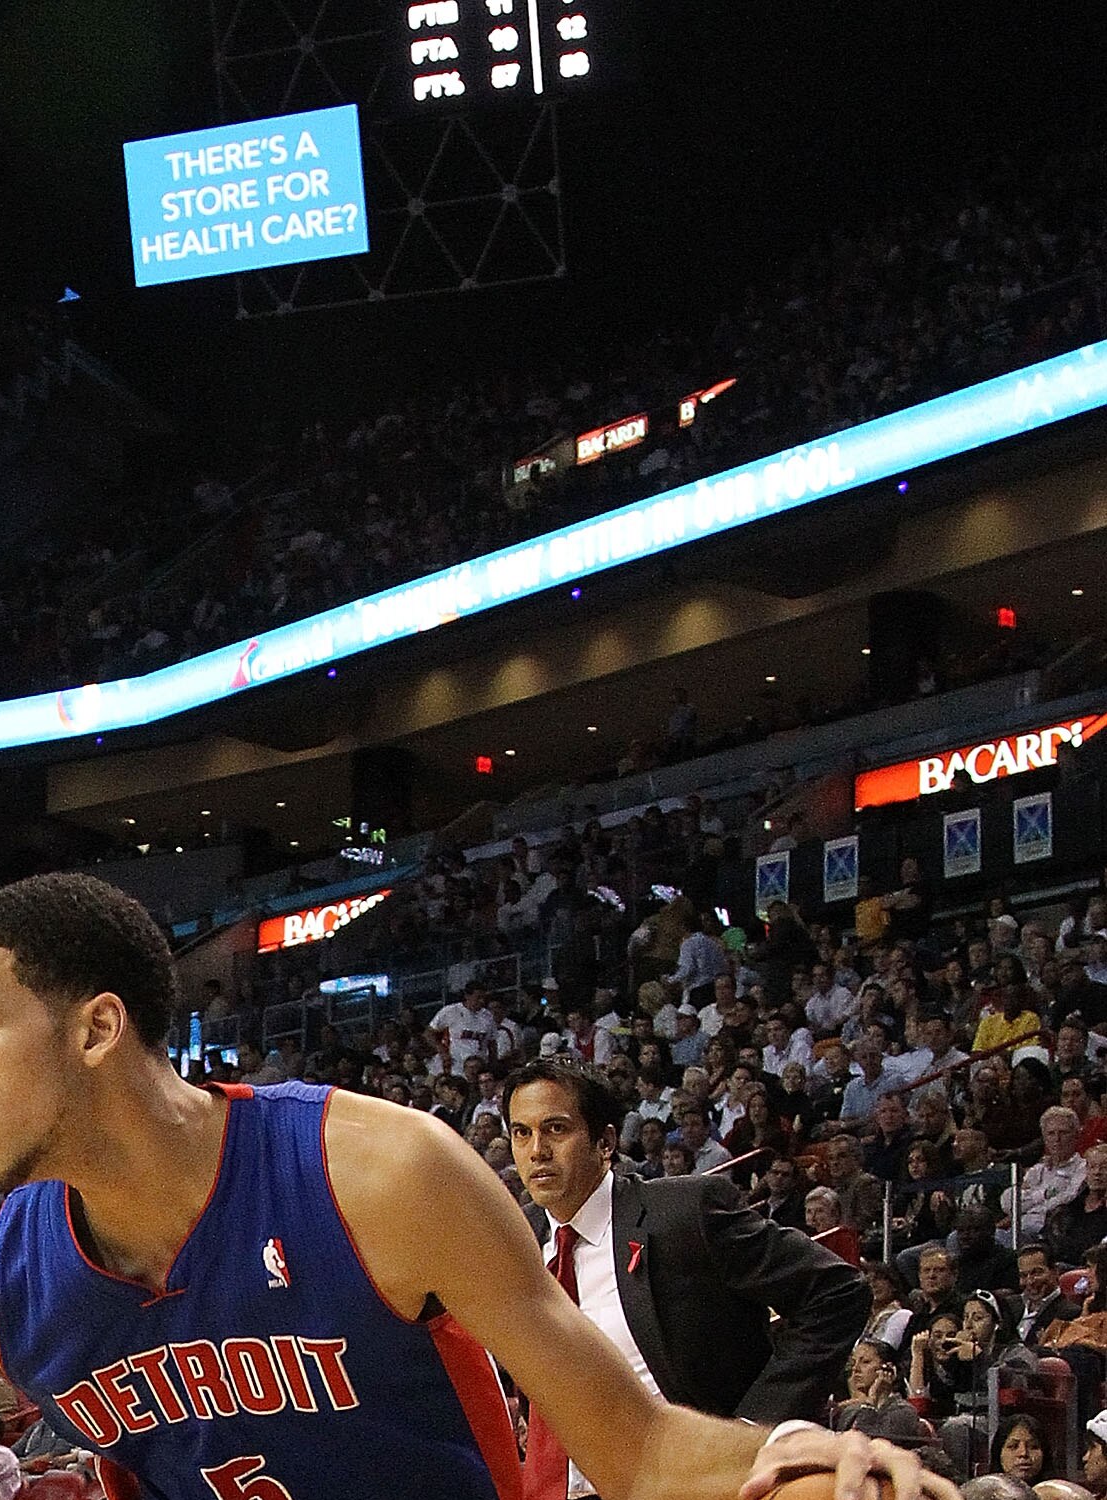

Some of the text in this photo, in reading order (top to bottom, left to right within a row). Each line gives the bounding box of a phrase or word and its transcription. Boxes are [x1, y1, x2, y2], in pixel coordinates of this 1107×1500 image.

[411, 37, 459, 65] FTA
[164, 131, 320, 181] THERE'S A
[161, 168, 330, 222] STORE FOR
[141, 203, 358, 264] HEALTH CARE?
[52, 1335, 360, 1448] DETROIT
